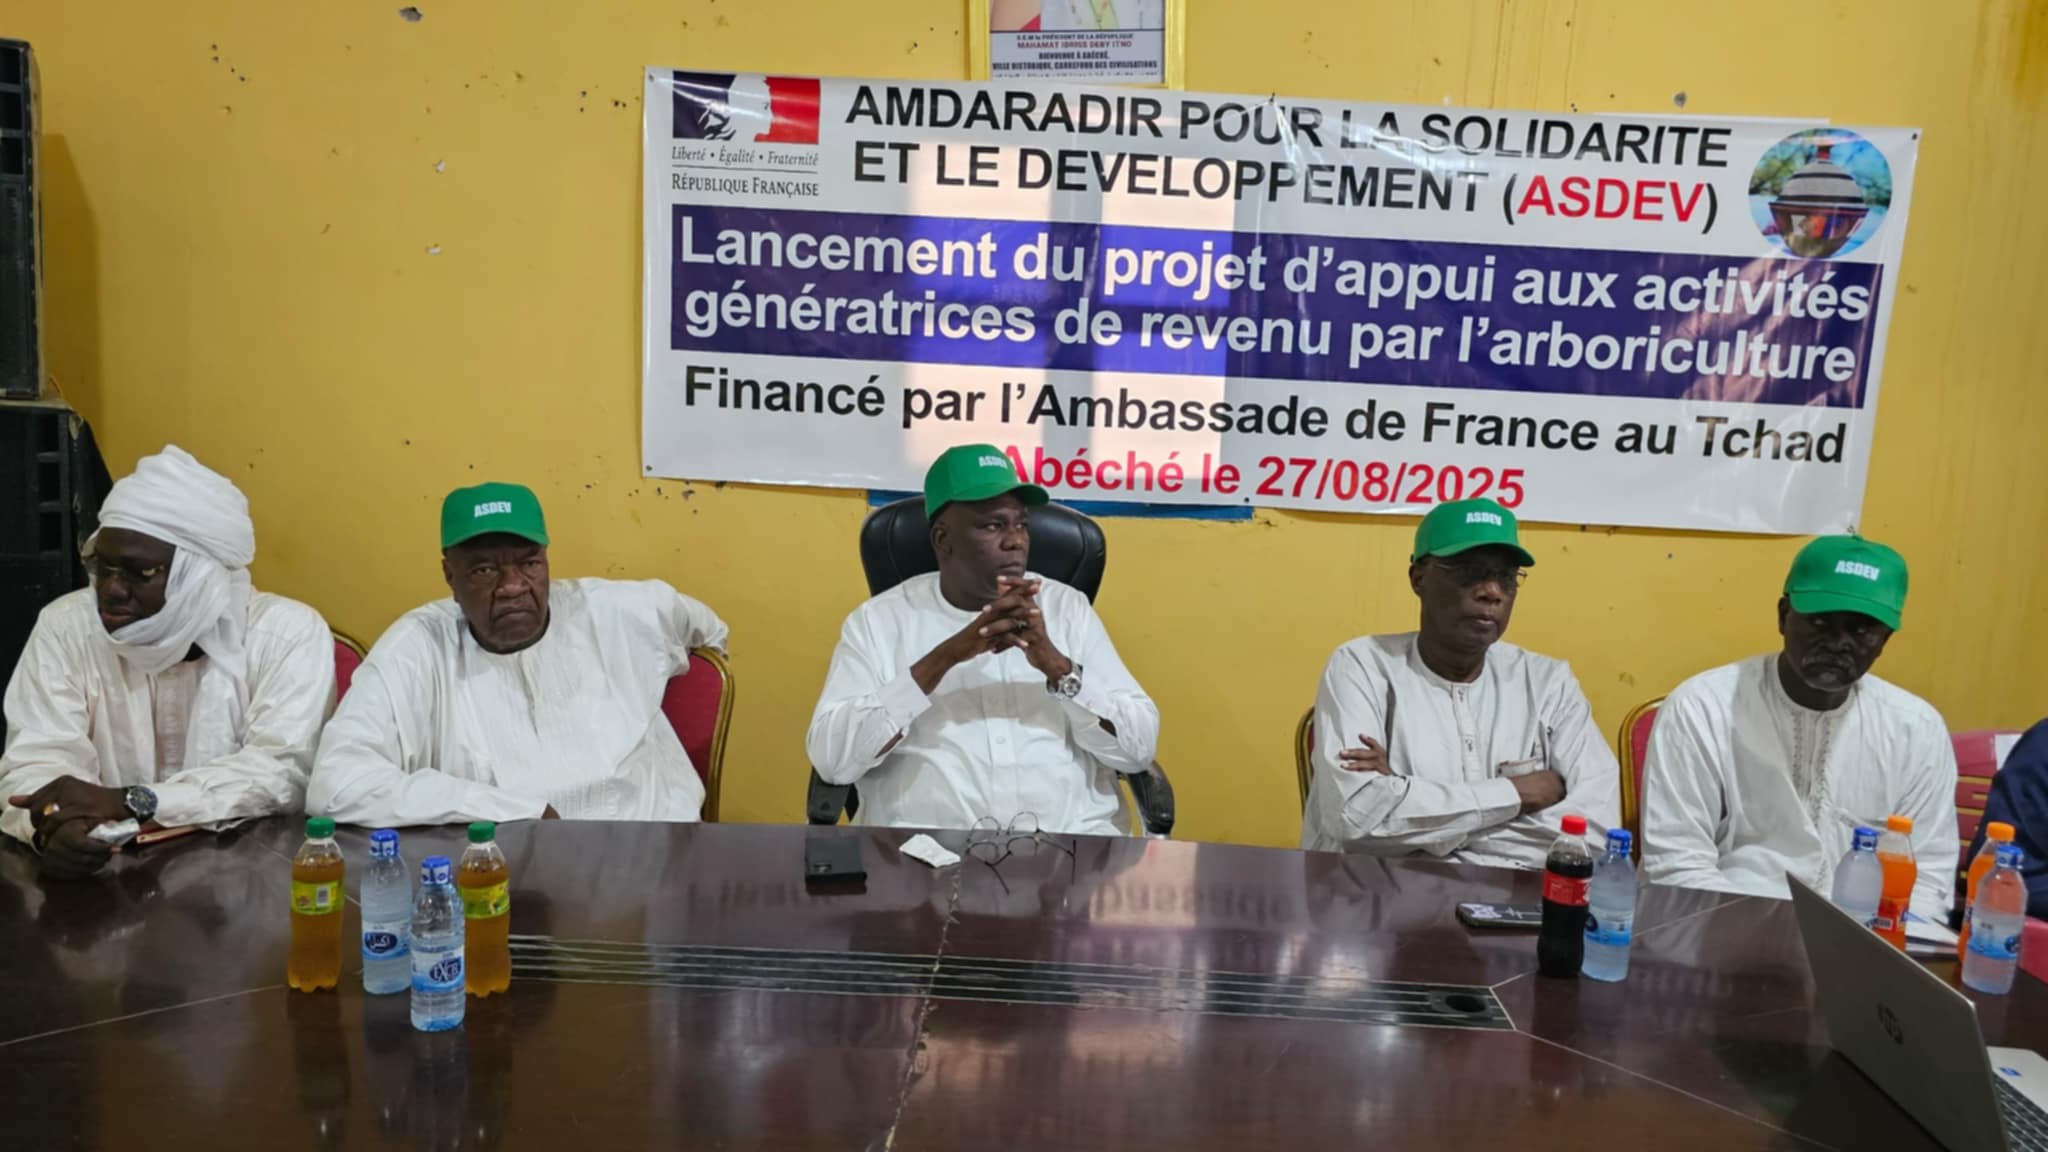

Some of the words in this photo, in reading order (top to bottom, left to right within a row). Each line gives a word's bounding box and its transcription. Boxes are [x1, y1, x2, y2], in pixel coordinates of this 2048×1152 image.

[671, 146, 707, 160] Liberté
[719, 145, 755, 166] Égalité
[767, 151, 819, 166] Fraternité
[845, 85, 1164, 139] AMDARADIR
[1179, 99, 1324, 148] POUR
[1340, 109, 1404, 151] LA
[1421, 113, 1732, 168] SOLIDARITE
[853, 140, 920, 184] ET
[937, 144, 1000, 187] LE
[1018, 147, 1489, 212] DEVELOPPEMENT
[1503, 172, 1718, 234] (ASDEV)
[681, 215, 997, 279] Lancement
[1013, 232, 1085, 282] du
[1104, 241, 1266, 301] projet
[1512, 267, 1619, 308] aux
[1633, 267, 1870, 322] activités
[684, 280, 1036, 343] génératrices
[1053, 296, 1122, 347] de
[1140, 310, 1332, 355] revenu
[1349, 320, 1443, 368] par
[684, 365, 885, 417] Financé
[902, 385, 986, 429] par
[1345, 399, 1406, 441] de
[1423, 401, 1599, 451] France
[1614, 421, 1677, 455] au
[1696, 416, 1846, 464] Tchad
[474, 501, 512, 518] ASDEV
[1201, 453, 1241, 494] le
[1255, 455, 1525, 509] 27/08/2025
[1466, 512, 1502, 526] ASDEV
[1834, 560, 1880, 581] ASDEV
